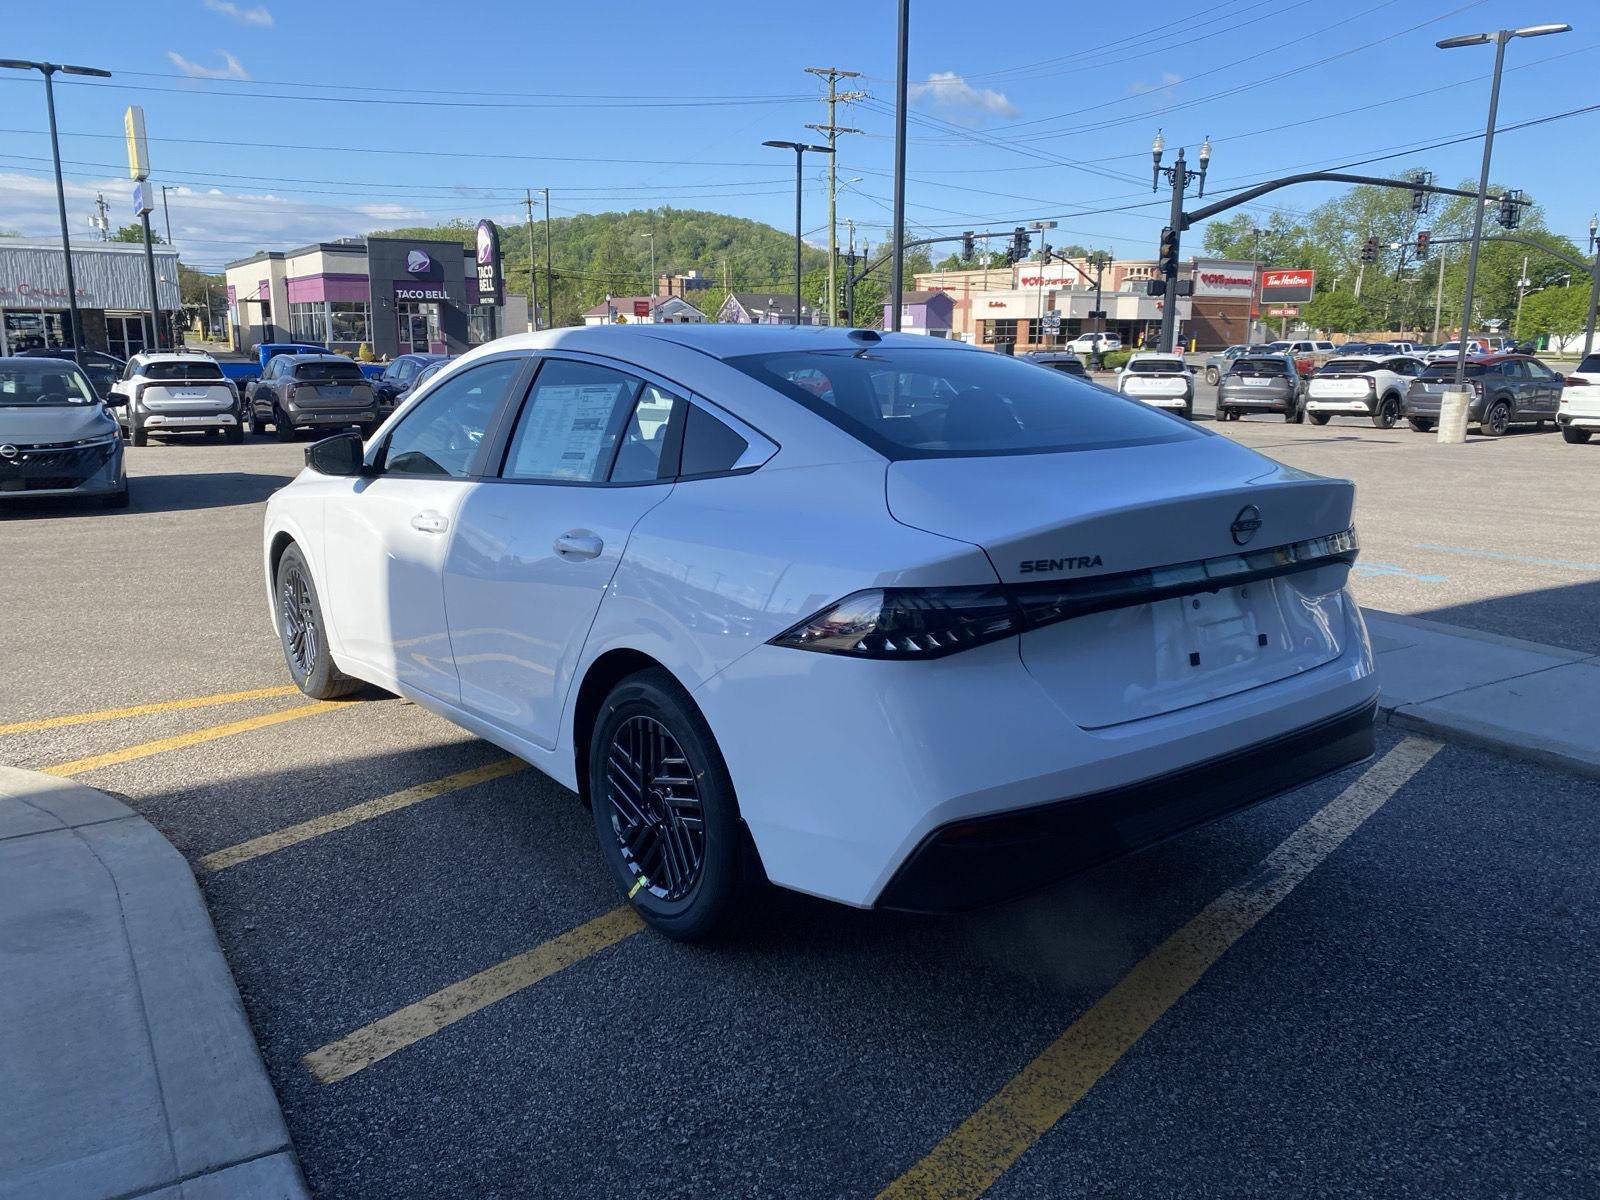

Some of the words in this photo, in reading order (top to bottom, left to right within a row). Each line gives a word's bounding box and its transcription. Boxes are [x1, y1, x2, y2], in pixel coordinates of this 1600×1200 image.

[477, 265, 493, 279] TACO
[1028, 276, 1044, 287] CVS
[1045, 277, 1075, 287] pharmacy
[1209, 274, 1224, 284] CVS
[1267, 275, 1280, 286] Tim
[1280, 274, 1308, 285] Hortons
[479, 279, 494, 292] BELL
[396, 289, 423, 299] TACO
[425, 290, 450, 299] BELL
[1020, 555, 1103, 573] SENTRA
